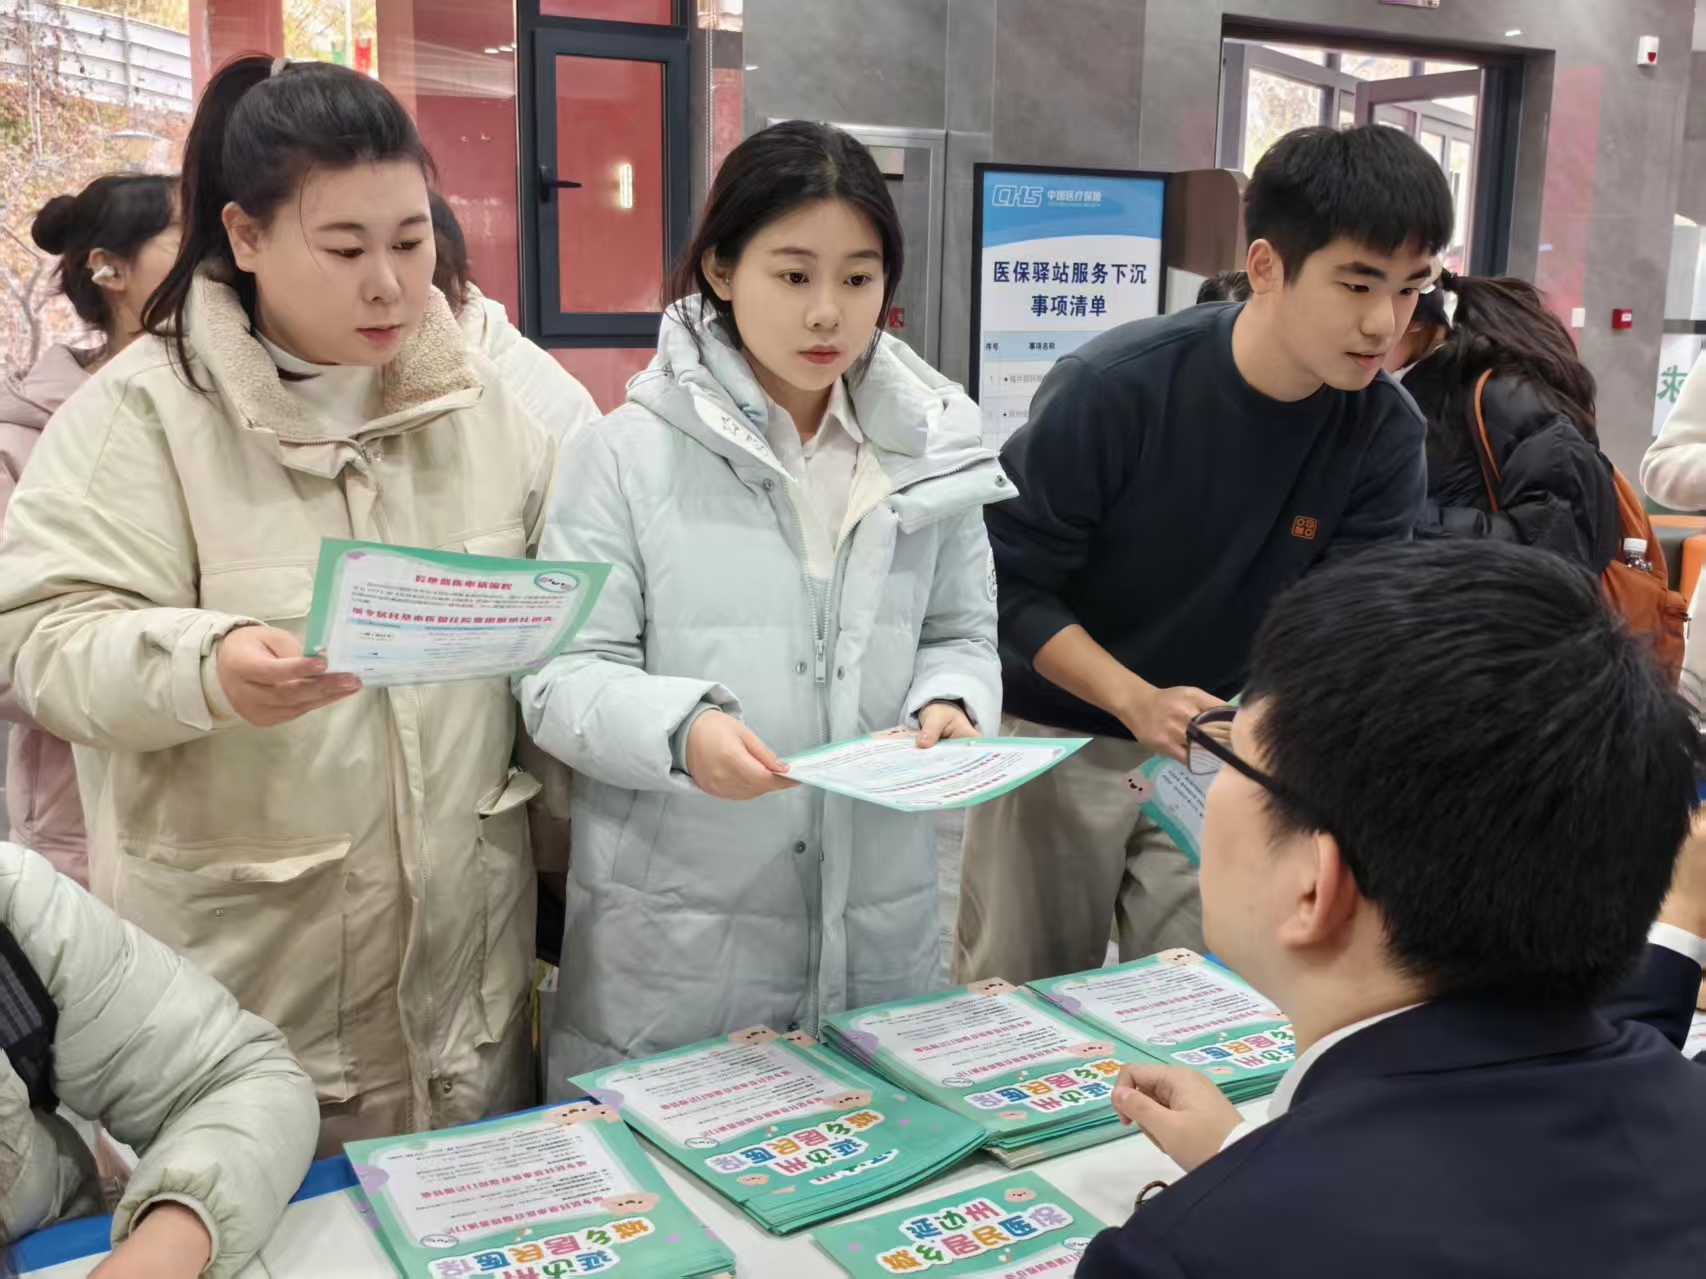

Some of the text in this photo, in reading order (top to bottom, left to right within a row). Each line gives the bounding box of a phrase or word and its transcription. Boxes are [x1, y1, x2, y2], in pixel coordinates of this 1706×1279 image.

[993, 261, 1147, 285] 医保驿站服务下沉
[1031, 295, 1107, 317] 事项清单
[1177, 1028, 1296, 1064] 乡居民医保
[1031, 1081, 1114, 1111] 延边州
[714, 1110, 880, 1171] 城乡居民医保
[774, 1138, 863, 1174] 延边州
[906, 1200, 1002, 1239] 延边州
[436, 1219, 649, 1278] 城乡居民医保
[882, 1206, 1067, 1271] 城乡居民医保
